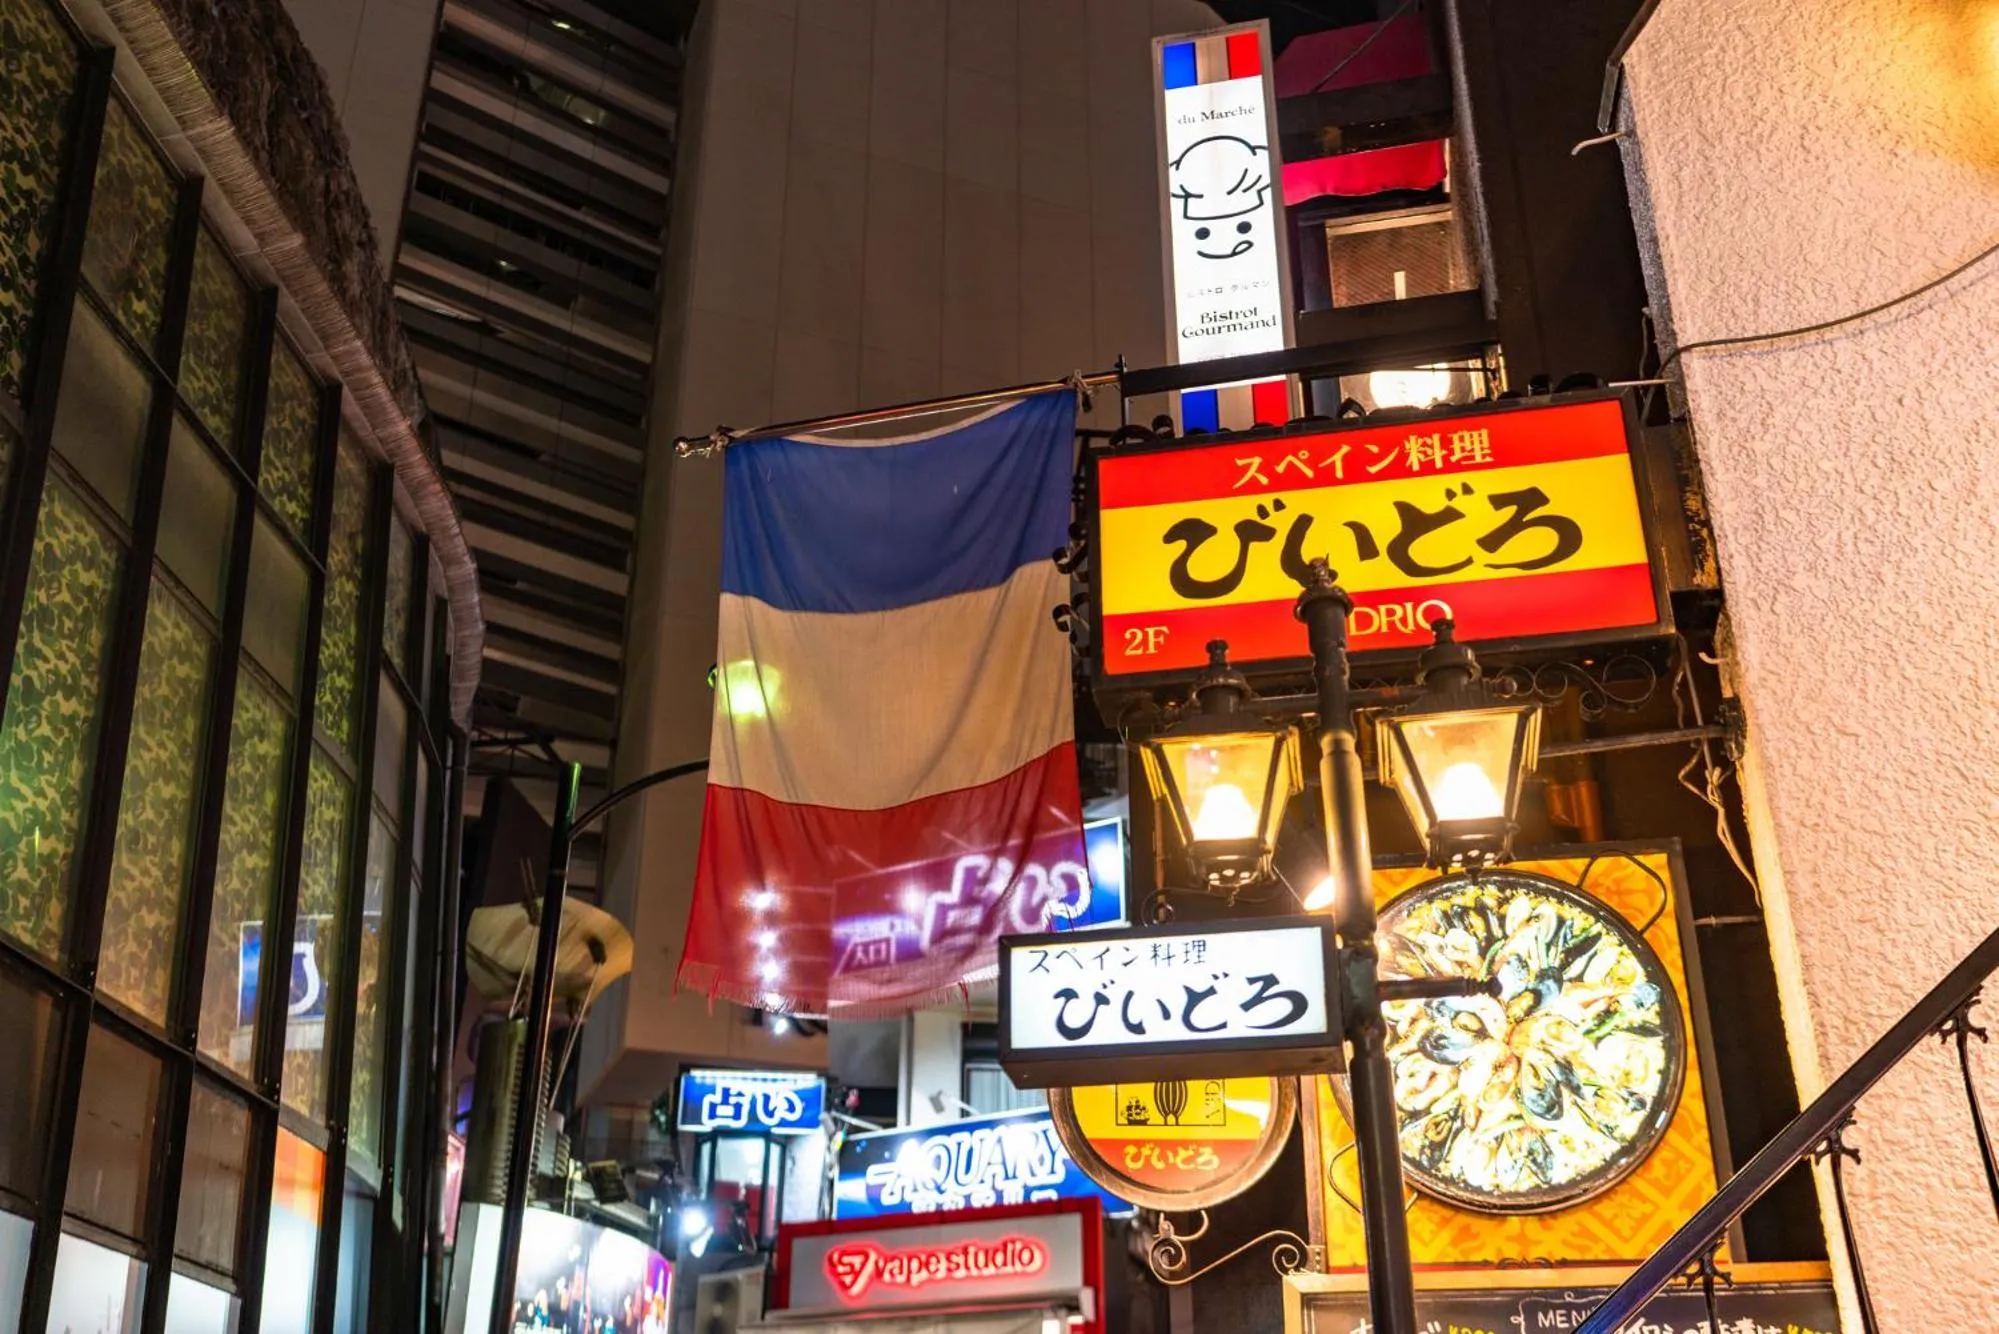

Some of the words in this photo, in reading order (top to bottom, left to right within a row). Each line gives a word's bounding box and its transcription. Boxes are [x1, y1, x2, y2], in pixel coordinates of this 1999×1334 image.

[1181, 314, 1277, 339] Gourmand
[1200, 306, 1258, 325] Bistrot
[1232, 427, 1495, 490] スペイン料理
[1162, 481, 1583, 600] びいどろ
[1123, 625, 1169, 657] 2F
[1349, 598, 1453, 637] DRIO
[1029, 939, 1207, 974] スペイン料理
[1053, 971, 1309, 1041] びいどろ
[702, 1082, 804, 1128] 占い
[1123, 1142, 1221, 1170] びいどろ
